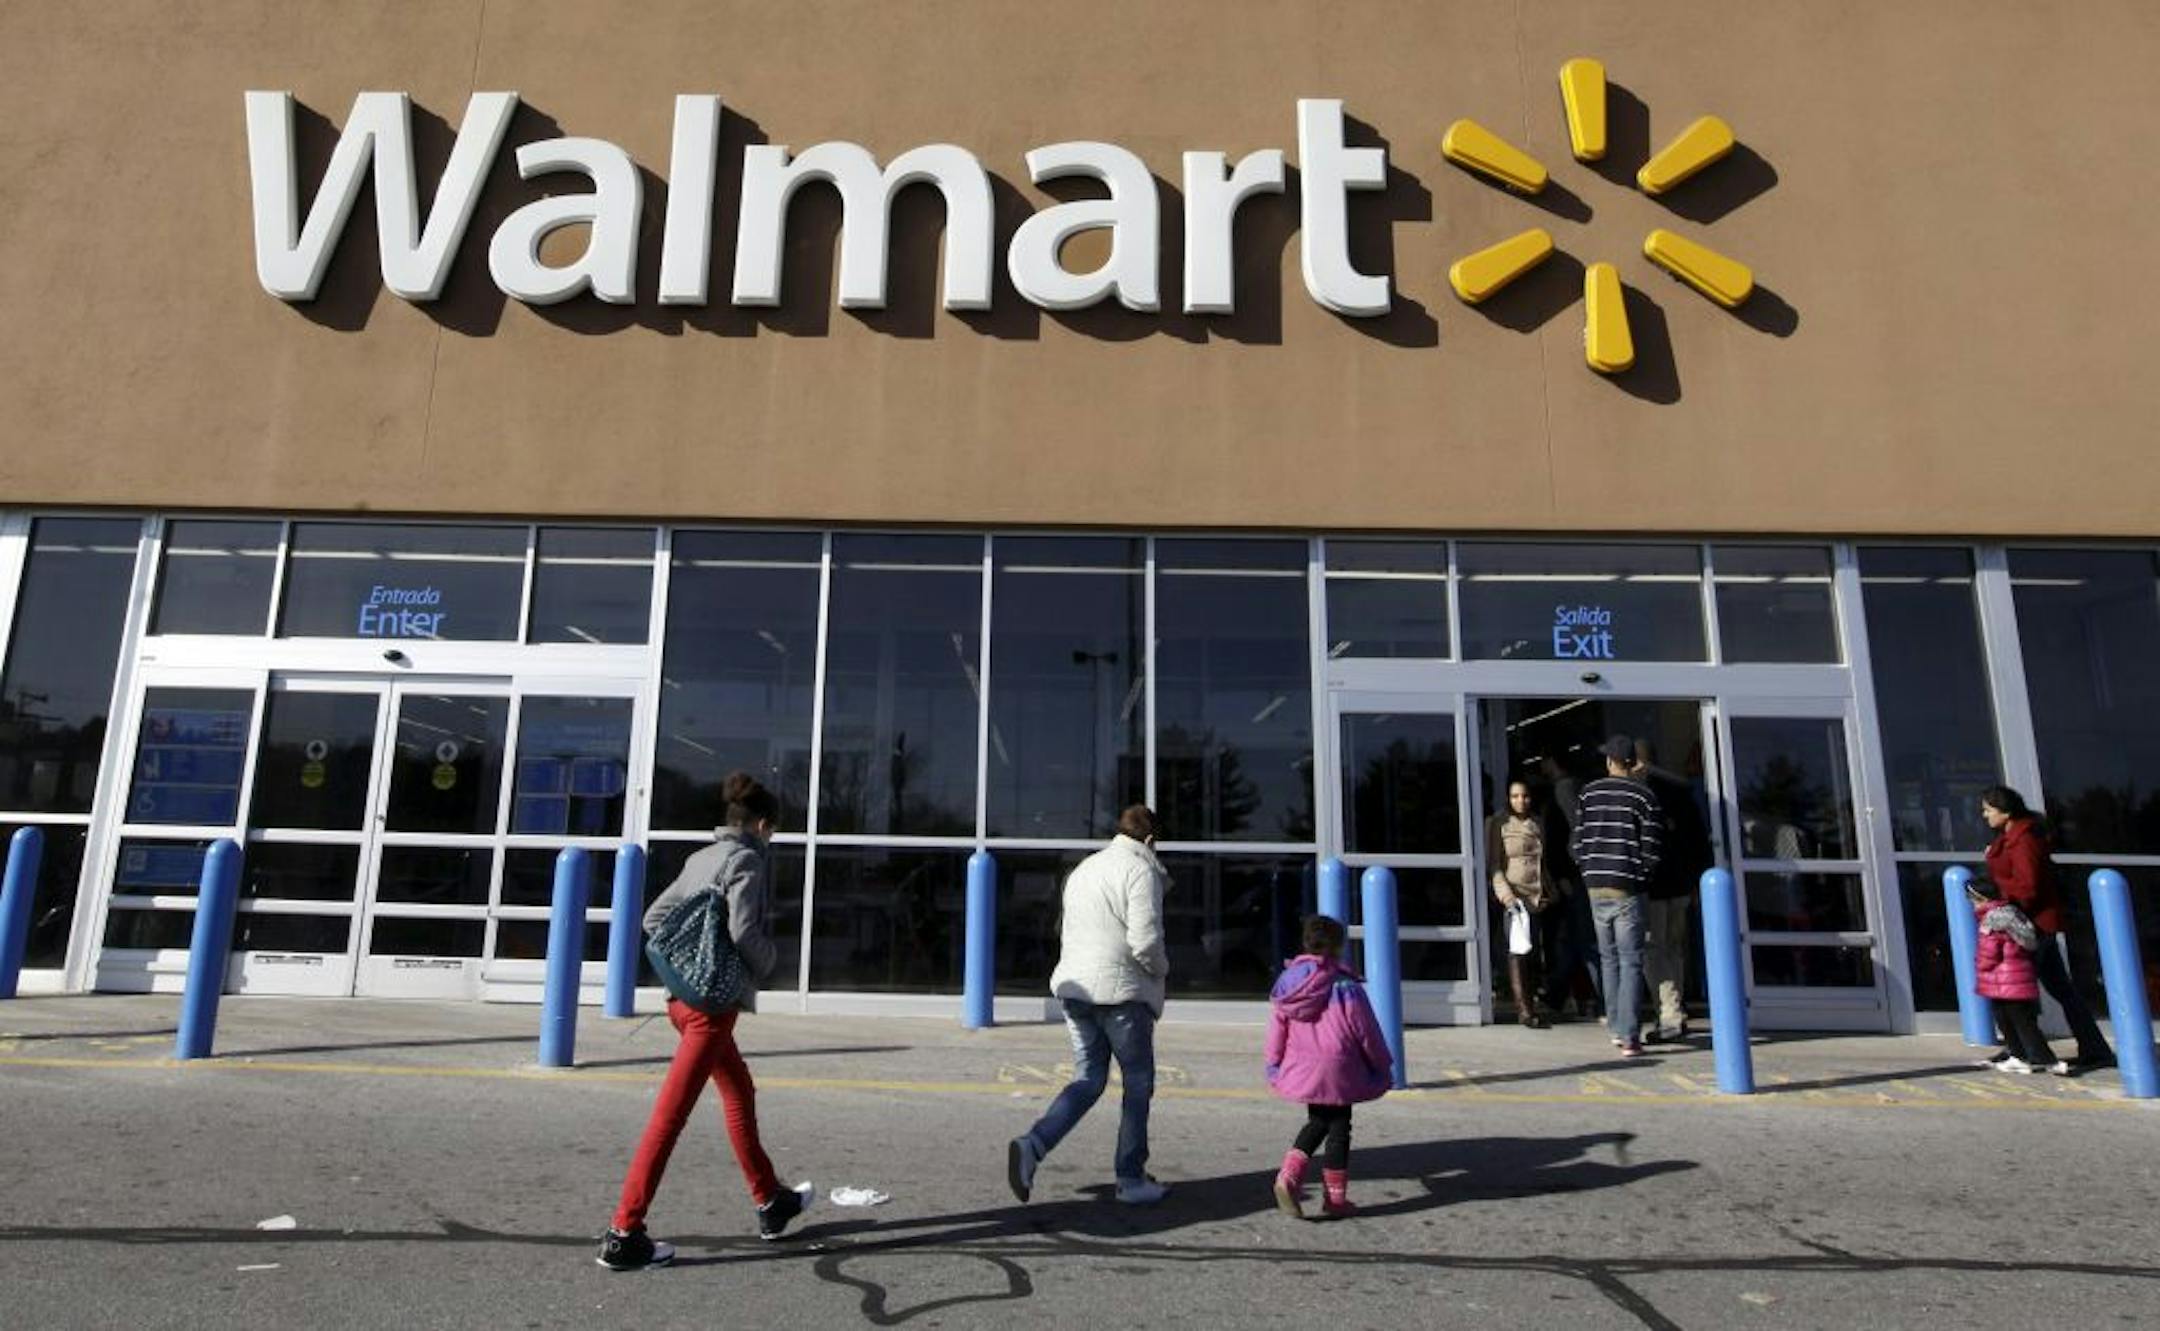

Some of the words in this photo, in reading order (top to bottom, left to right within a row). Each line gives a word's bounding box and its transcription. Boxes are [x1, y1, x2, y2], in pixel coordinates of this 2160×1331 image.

[244, 90, 1391, 317] Walmart
[370, 584, 442, 604] Entrada
[358, 603, 446, 637] Enter
[1554, 604, 1612, 625] Salida
[1552, 625, 1614, 658] Exit
